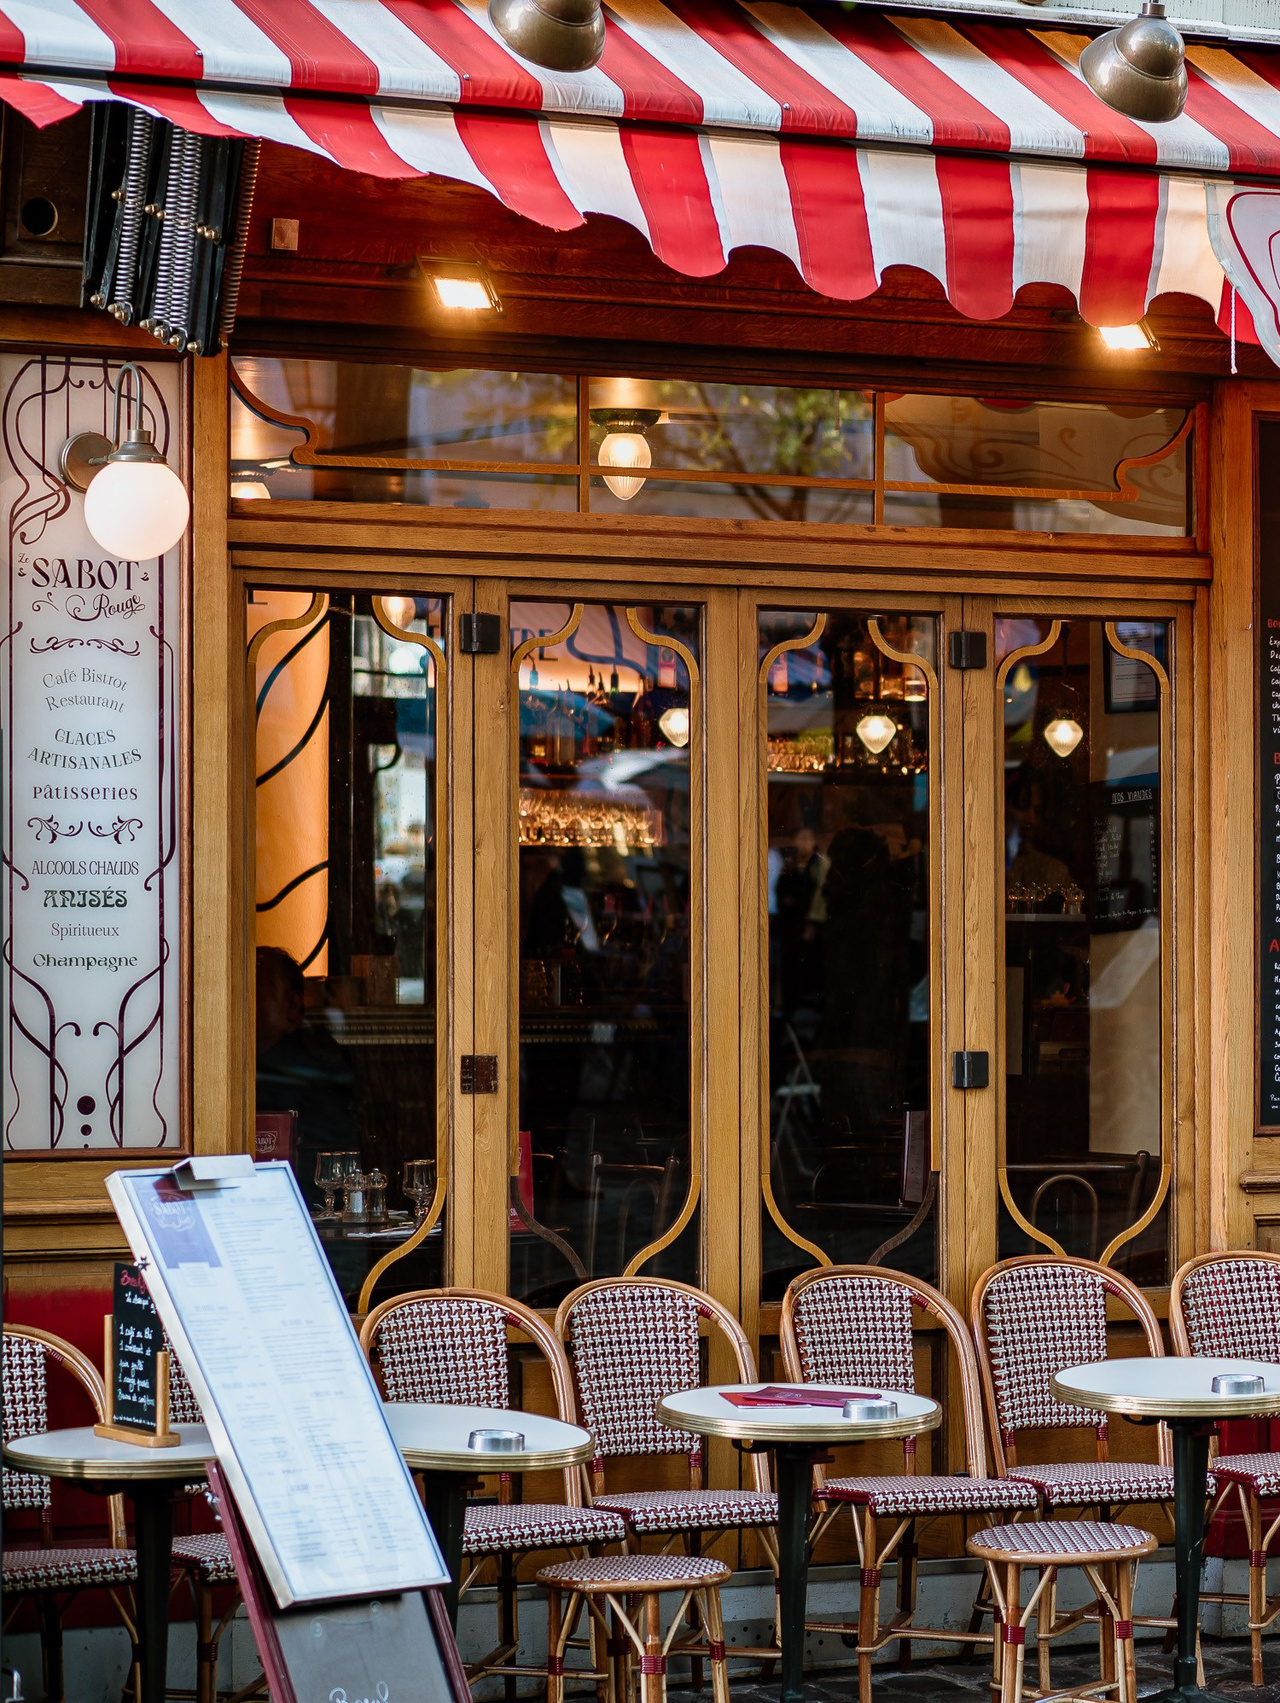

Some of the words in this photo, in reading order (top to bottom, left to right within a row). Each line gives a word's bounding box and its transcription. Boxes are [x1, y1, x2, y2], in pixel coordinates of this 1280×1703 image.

[31, 557, 141, 591] SABOT
[90, 592, 146, 620] Rouge
[42, 667, 78, 690] Café
[81, 666, 128, 692] Bistrot
[45, 694, 127, 713] Restaurant
[54, 728, 117, 747] GLACES
[27, 746, 143, 770] ARTISANALES
[31, 860, 88, 876] ALCOOLS
[89, 860, 140, 876] CHAUDS
[43, 886, 129, 909] ANISÉS
[50, 922, 120, 941] Spiritueux
[32, 953, 139, 973] Champagne
